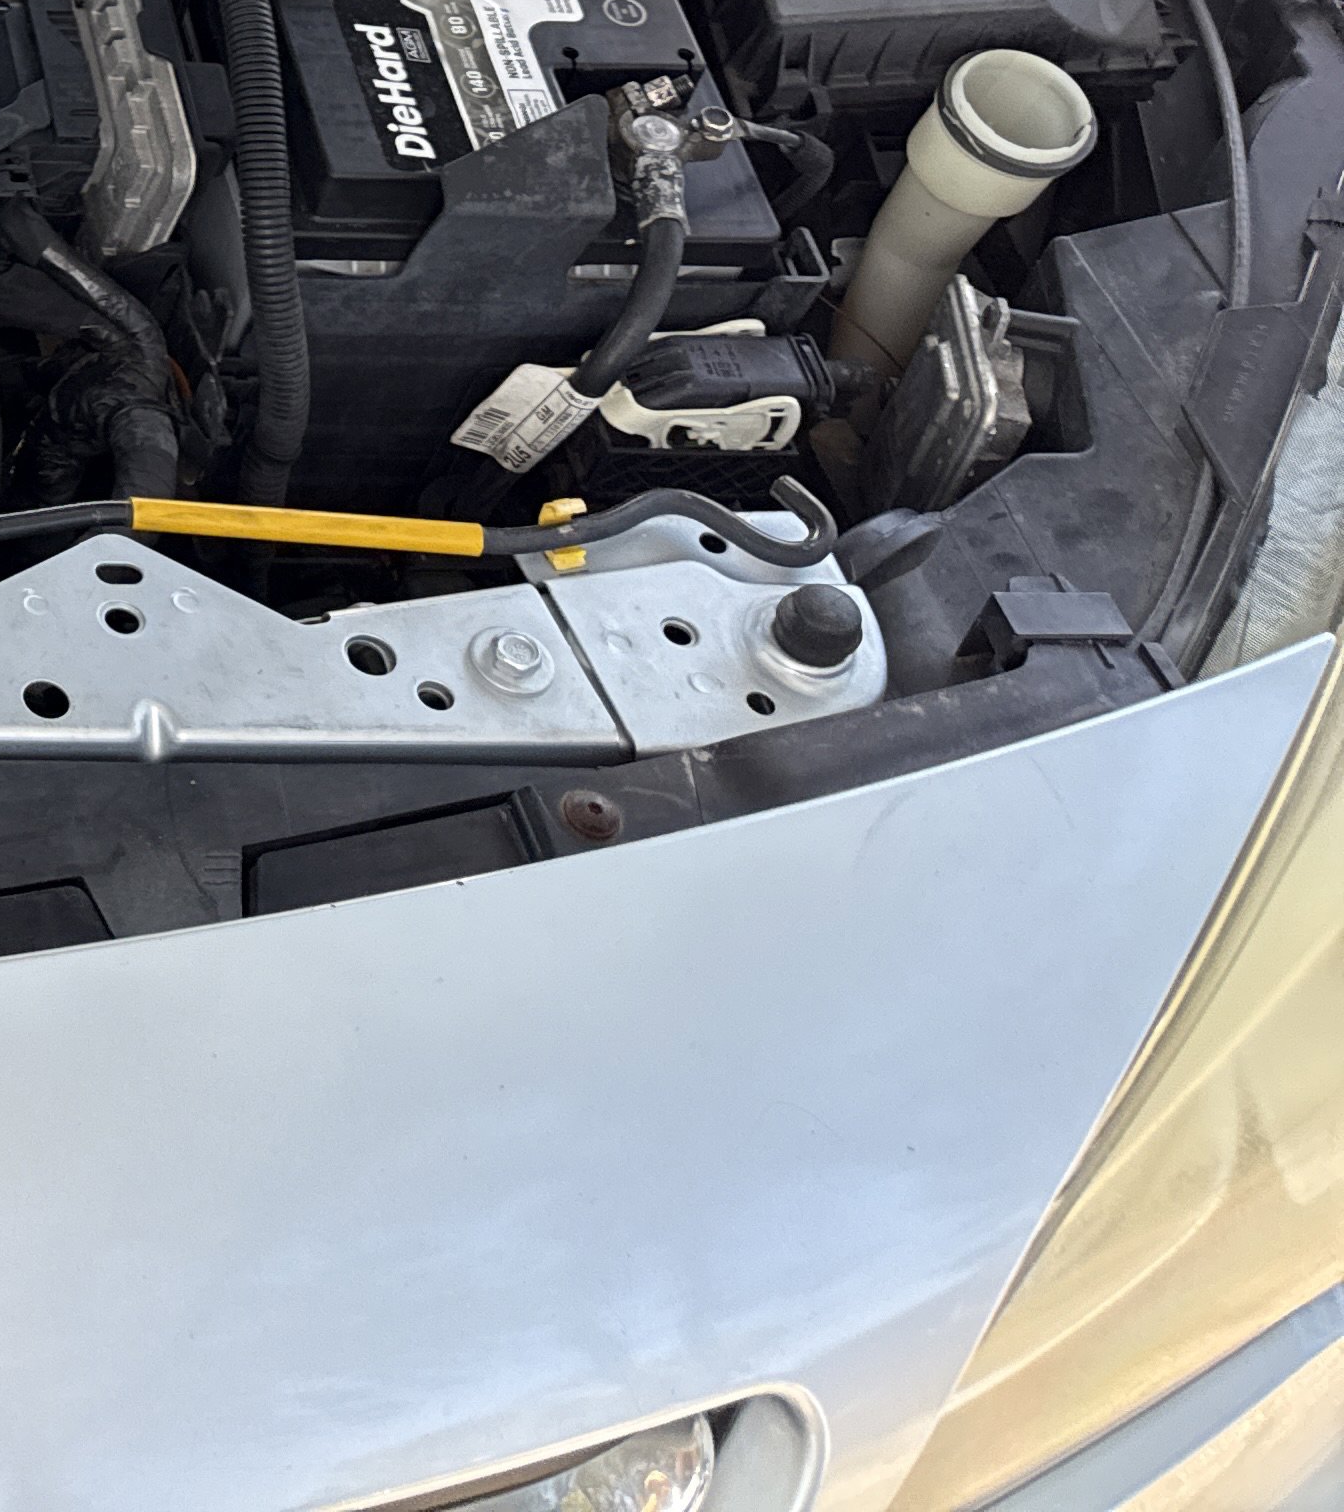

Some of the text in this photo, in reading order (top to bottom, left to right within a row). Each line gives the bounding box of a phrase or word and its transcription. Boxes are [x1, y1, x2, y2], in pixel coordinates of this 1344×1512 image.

[448, 16, 468, 34] 80
[483, 5, 521, 79] NON-SPILLABLE
[507, 39, 524, 58] Acid
[515, 58, 533, 79] Lead
[353, 22, 437, 160] DieHard
[464, 70, 489, 94] 140
[535, 404, 553, 422] GM
[503, 445, 532, 469] 2U5
